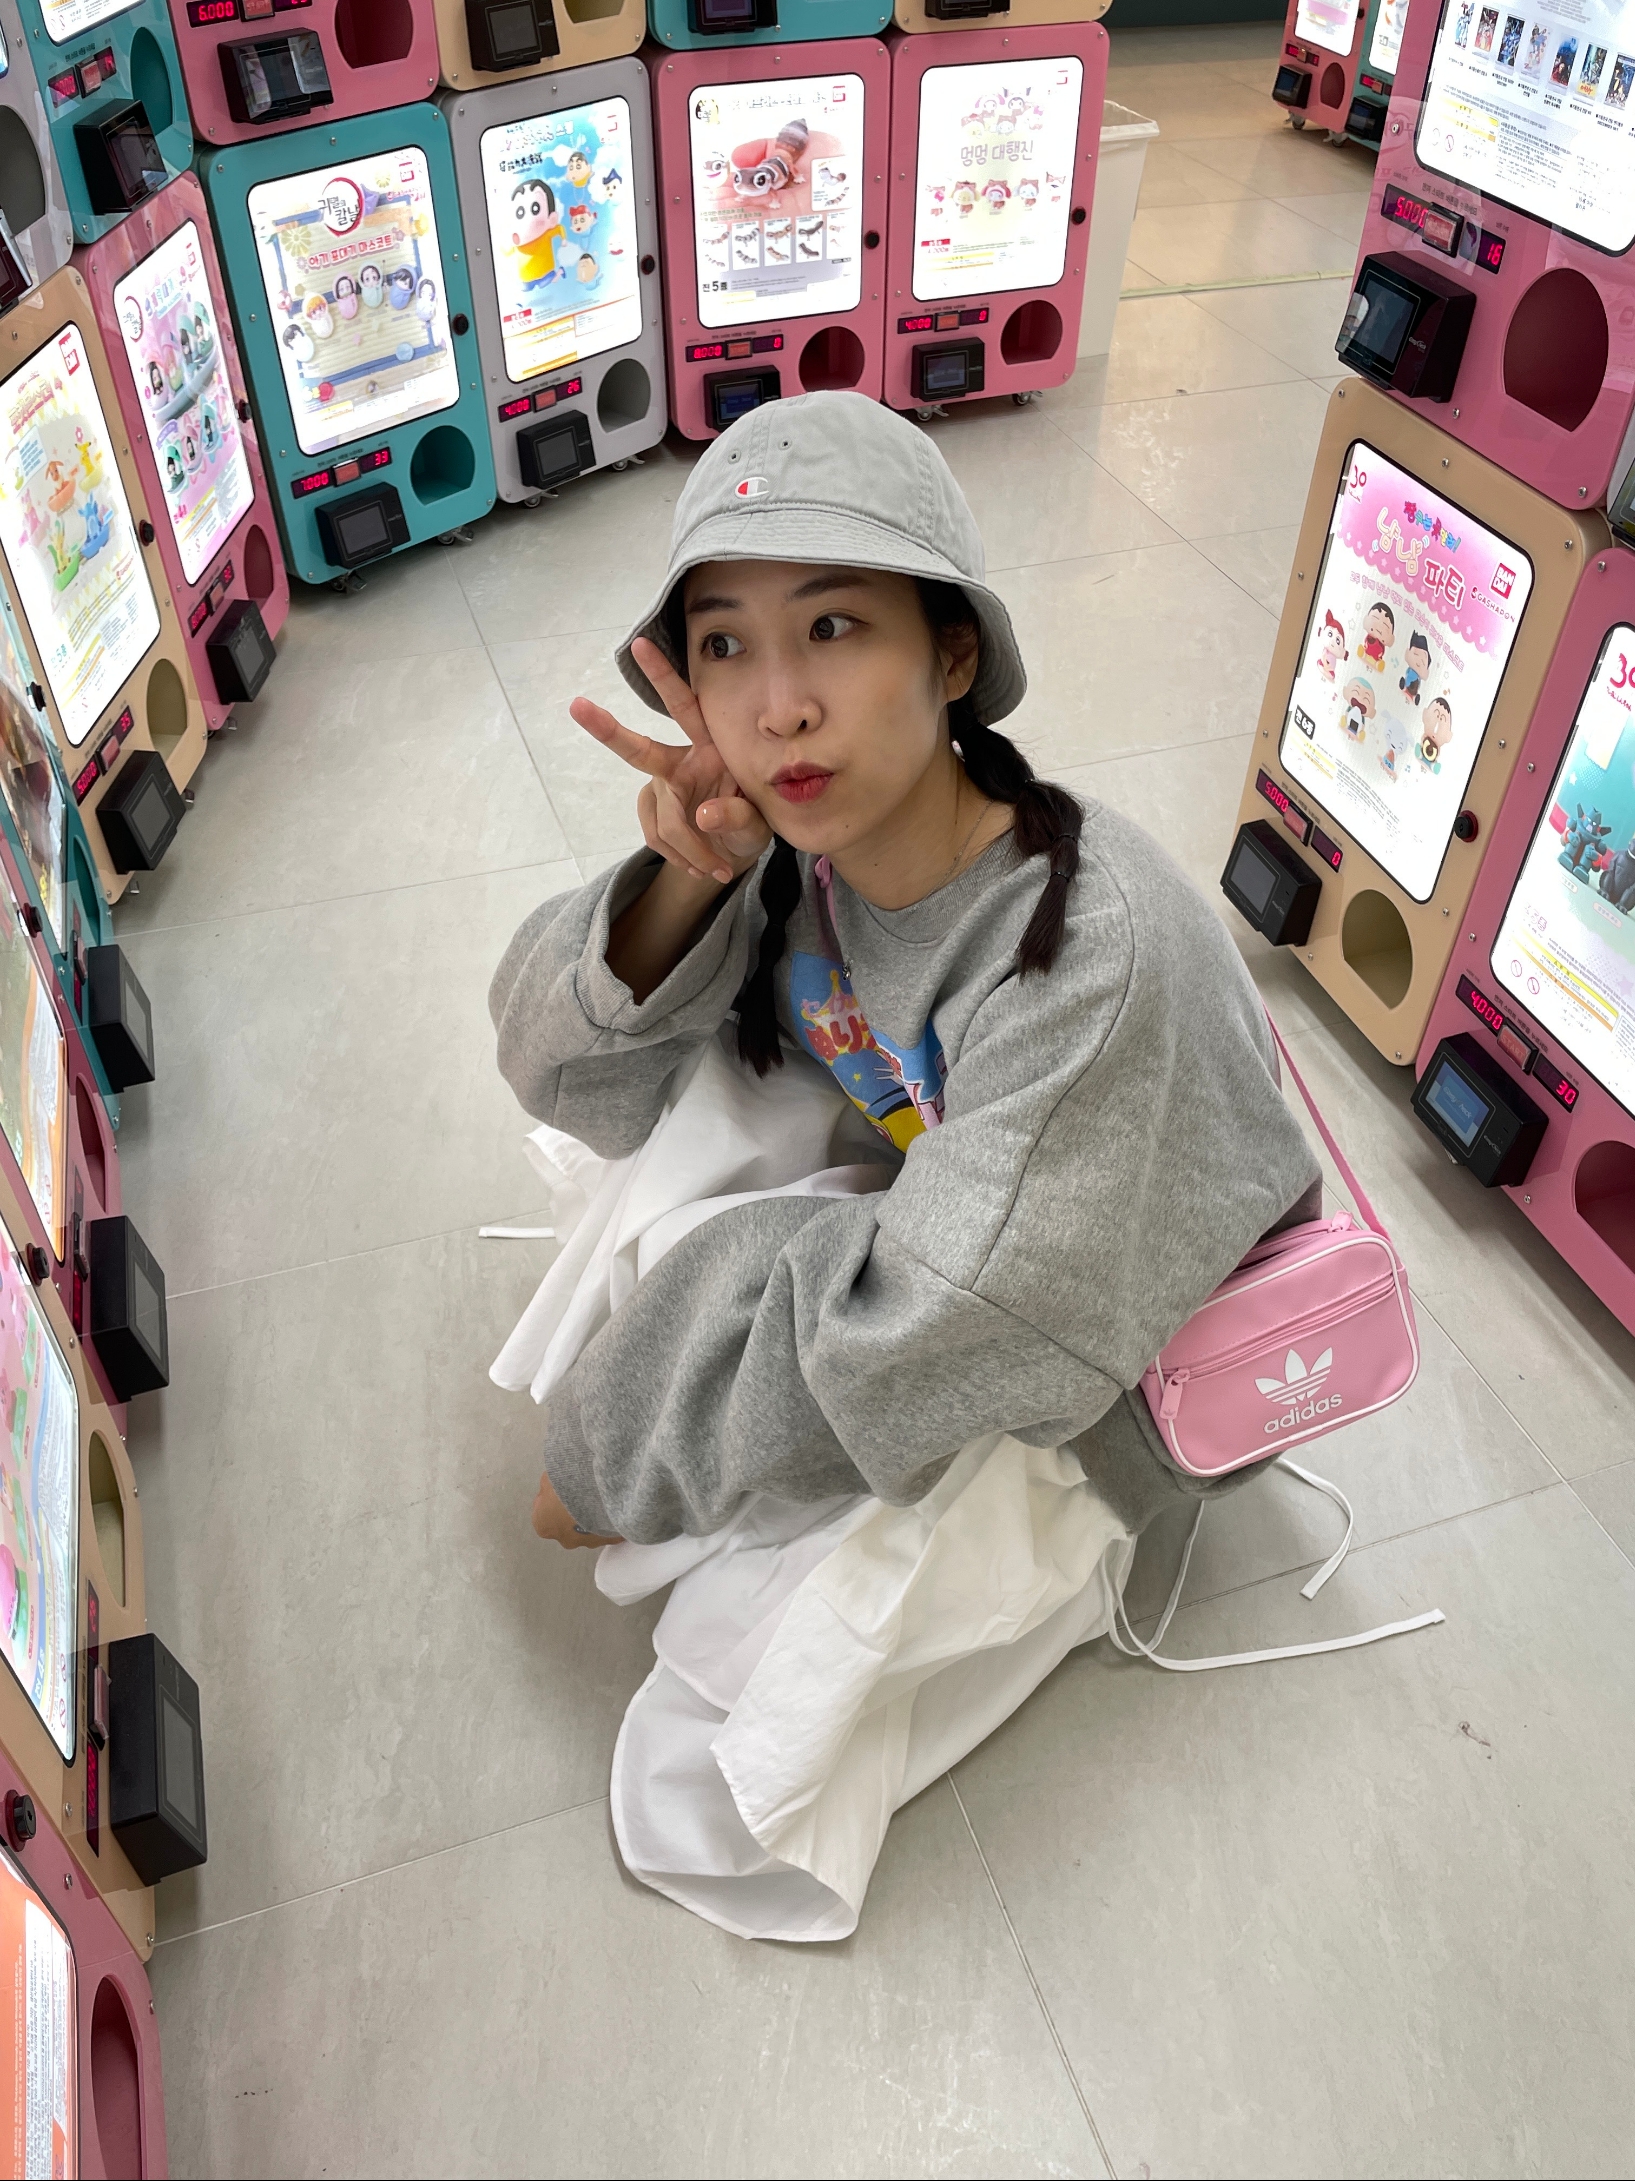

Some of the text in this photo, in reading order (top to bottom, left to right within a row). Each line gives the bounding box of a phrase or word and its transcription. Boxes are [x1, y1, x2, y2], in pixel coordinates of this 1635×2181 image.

[960, 140, 1034, 167] 멍멍 대행진
[308, 234, 394, 268] 아기 포대기 마스코트
[1377, 507, 1466, 610] 냠냠 파티
[1500, 1033, 1525, 1062] START
[1556, 1079, 1576, 1105] 30
[1263, 1394, 1343, 1434] adidas
